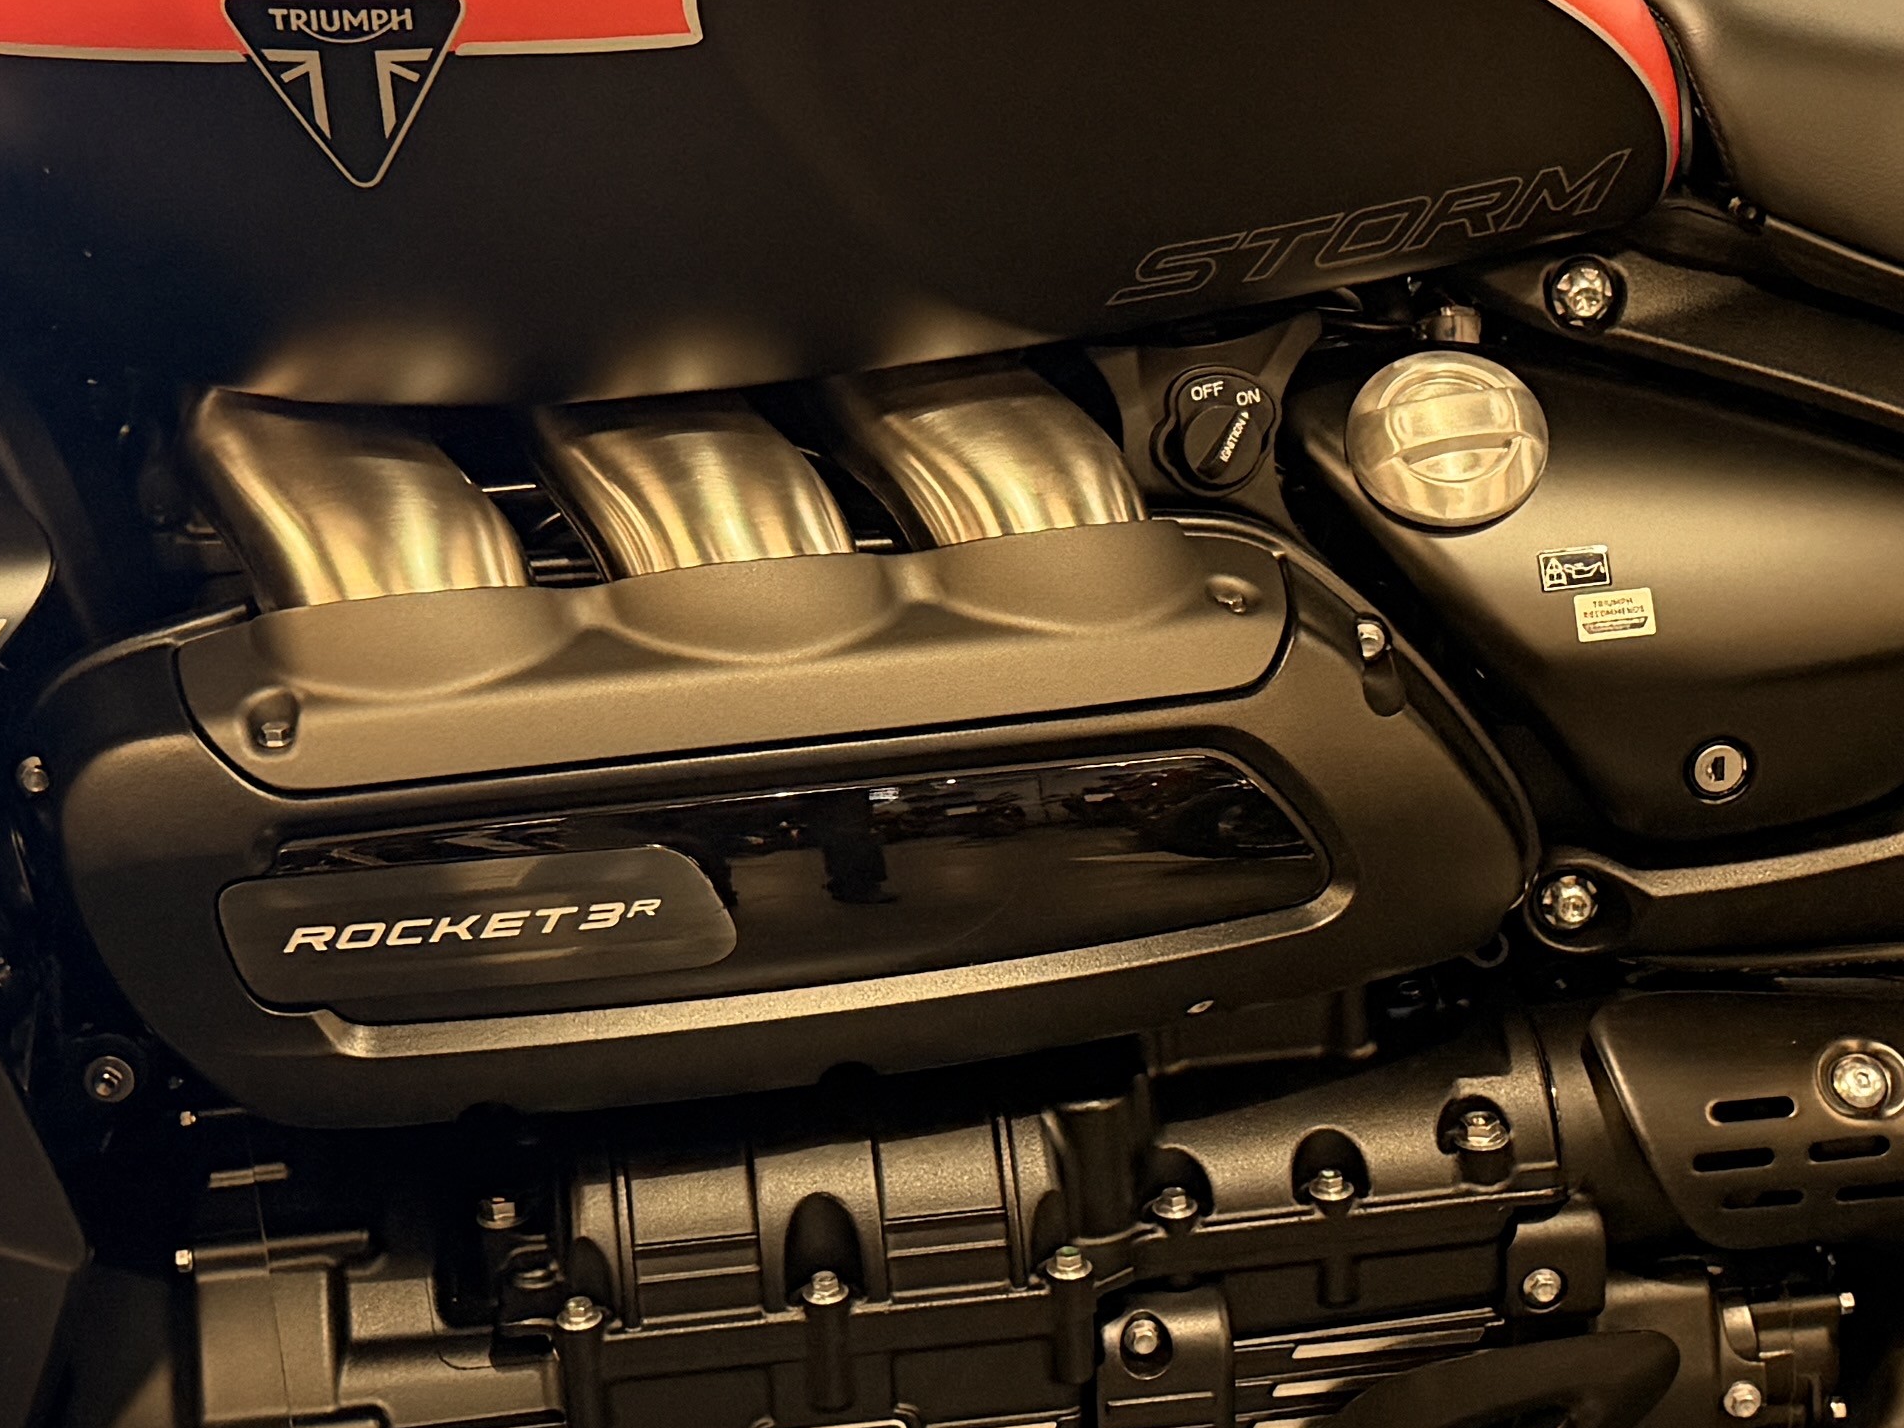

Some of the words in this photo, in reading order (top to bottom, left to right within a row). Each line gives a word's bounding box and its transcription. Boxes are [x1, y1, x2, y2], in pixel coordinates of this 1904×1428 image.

[267, 7, 414, 33] TRIUMPH
[1105, 149, 1632, 305] STORM
[1190, 380, 1224, 401] OFF
[1236, 387, 1261, 406] ON
[1219, 419, 1251, 463] IGNITION
